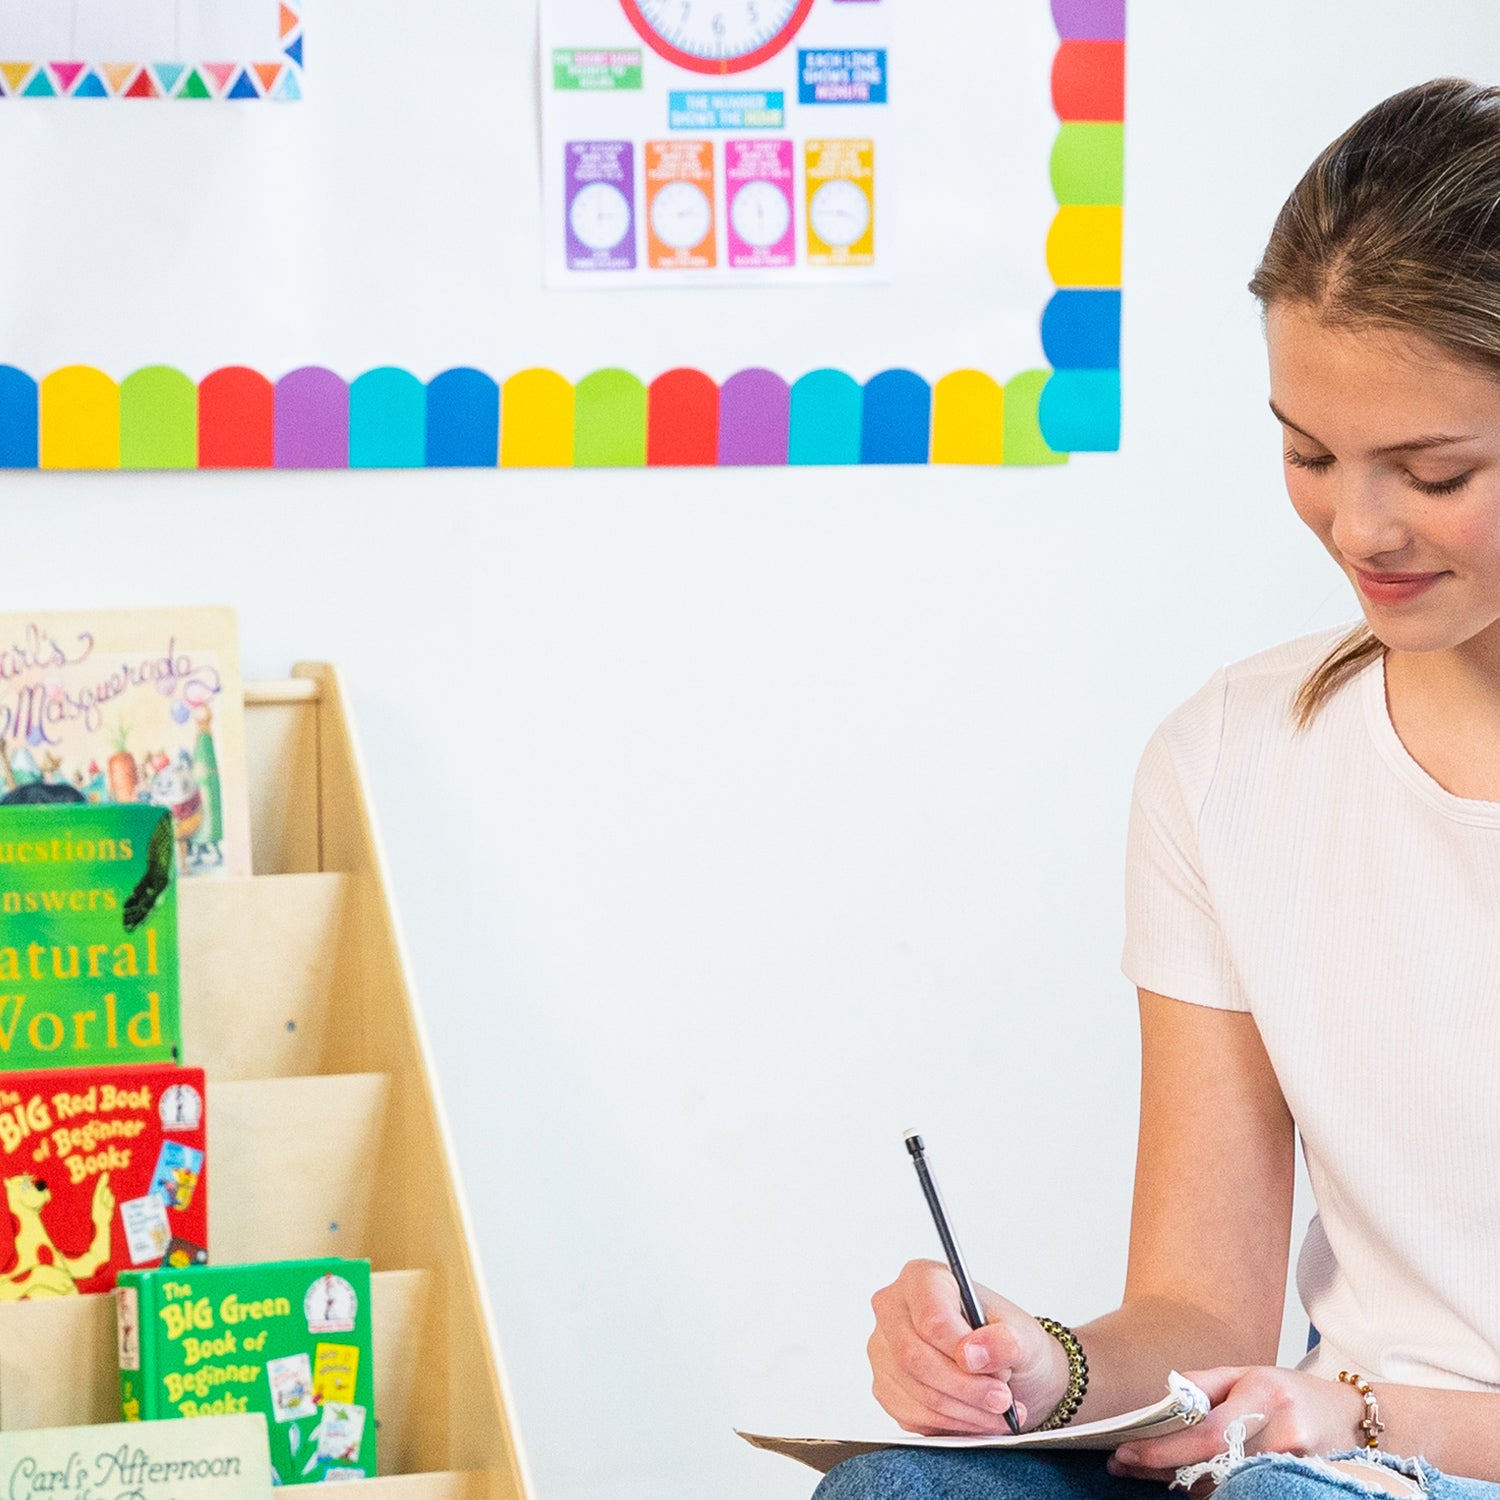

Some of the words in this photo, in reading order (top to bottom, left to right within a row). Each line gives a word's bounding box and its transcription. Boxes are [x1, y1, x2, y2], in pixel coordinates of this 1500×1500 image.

[711, 13, 725, 36] 6
[0, 831, 133, 863] uestions
[0, 888, 117, 914] nswers
[0, 928, 158, 981] atural
[0, 1094, 52, 1154] BIG
[52, 1085, 97, 1119] Red
[99, 1084, 151, 1112] Book
[32, 1137, 50, 1163] of
[52, 1119, 145, 1158] Beginner
[64, 1144, 132, 1185] Books
[162, 1281, 193, 1301] The
[159, 1296, 214, 1340] BIG
[219, 1293, 291, 1324] Green
[181, 1329, 237, 1366] Book
[242, 1330, 268, 1352] of
[163, 1364, 261, 1403] Beginner
[94, 1443, 241, 1488] Afternoon
